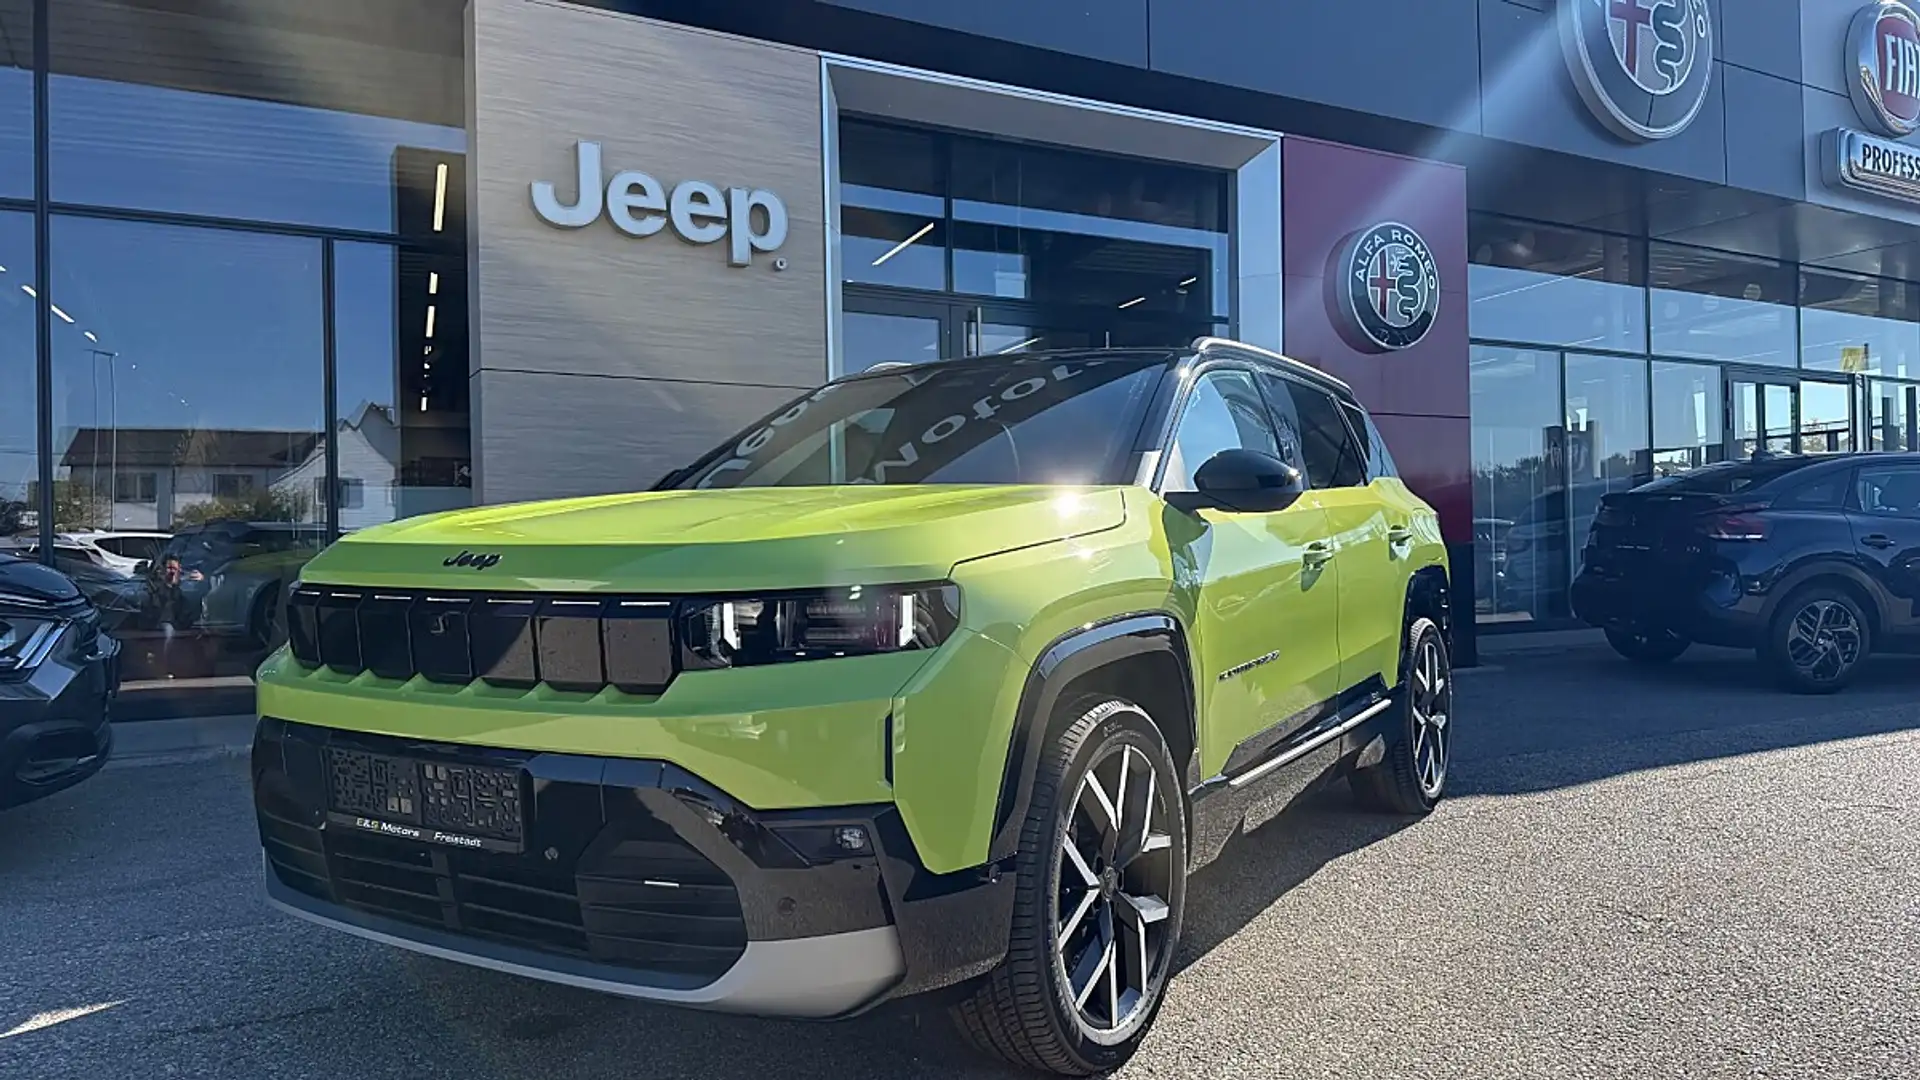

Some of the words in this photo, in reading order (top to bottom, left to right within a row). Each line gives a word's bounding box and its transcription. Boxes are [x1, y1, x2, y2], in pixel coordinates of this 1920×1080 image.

[530, 140, 789, 267] Jeep
[1355, 234, 1385, 282] ALFA
[1391, 229, 1436, 290] ROMEO
[443, 549, 502, 571] Jeep
[381, 822, 420, 837] Motors
[433, 831, 482, 847] Freistadt
